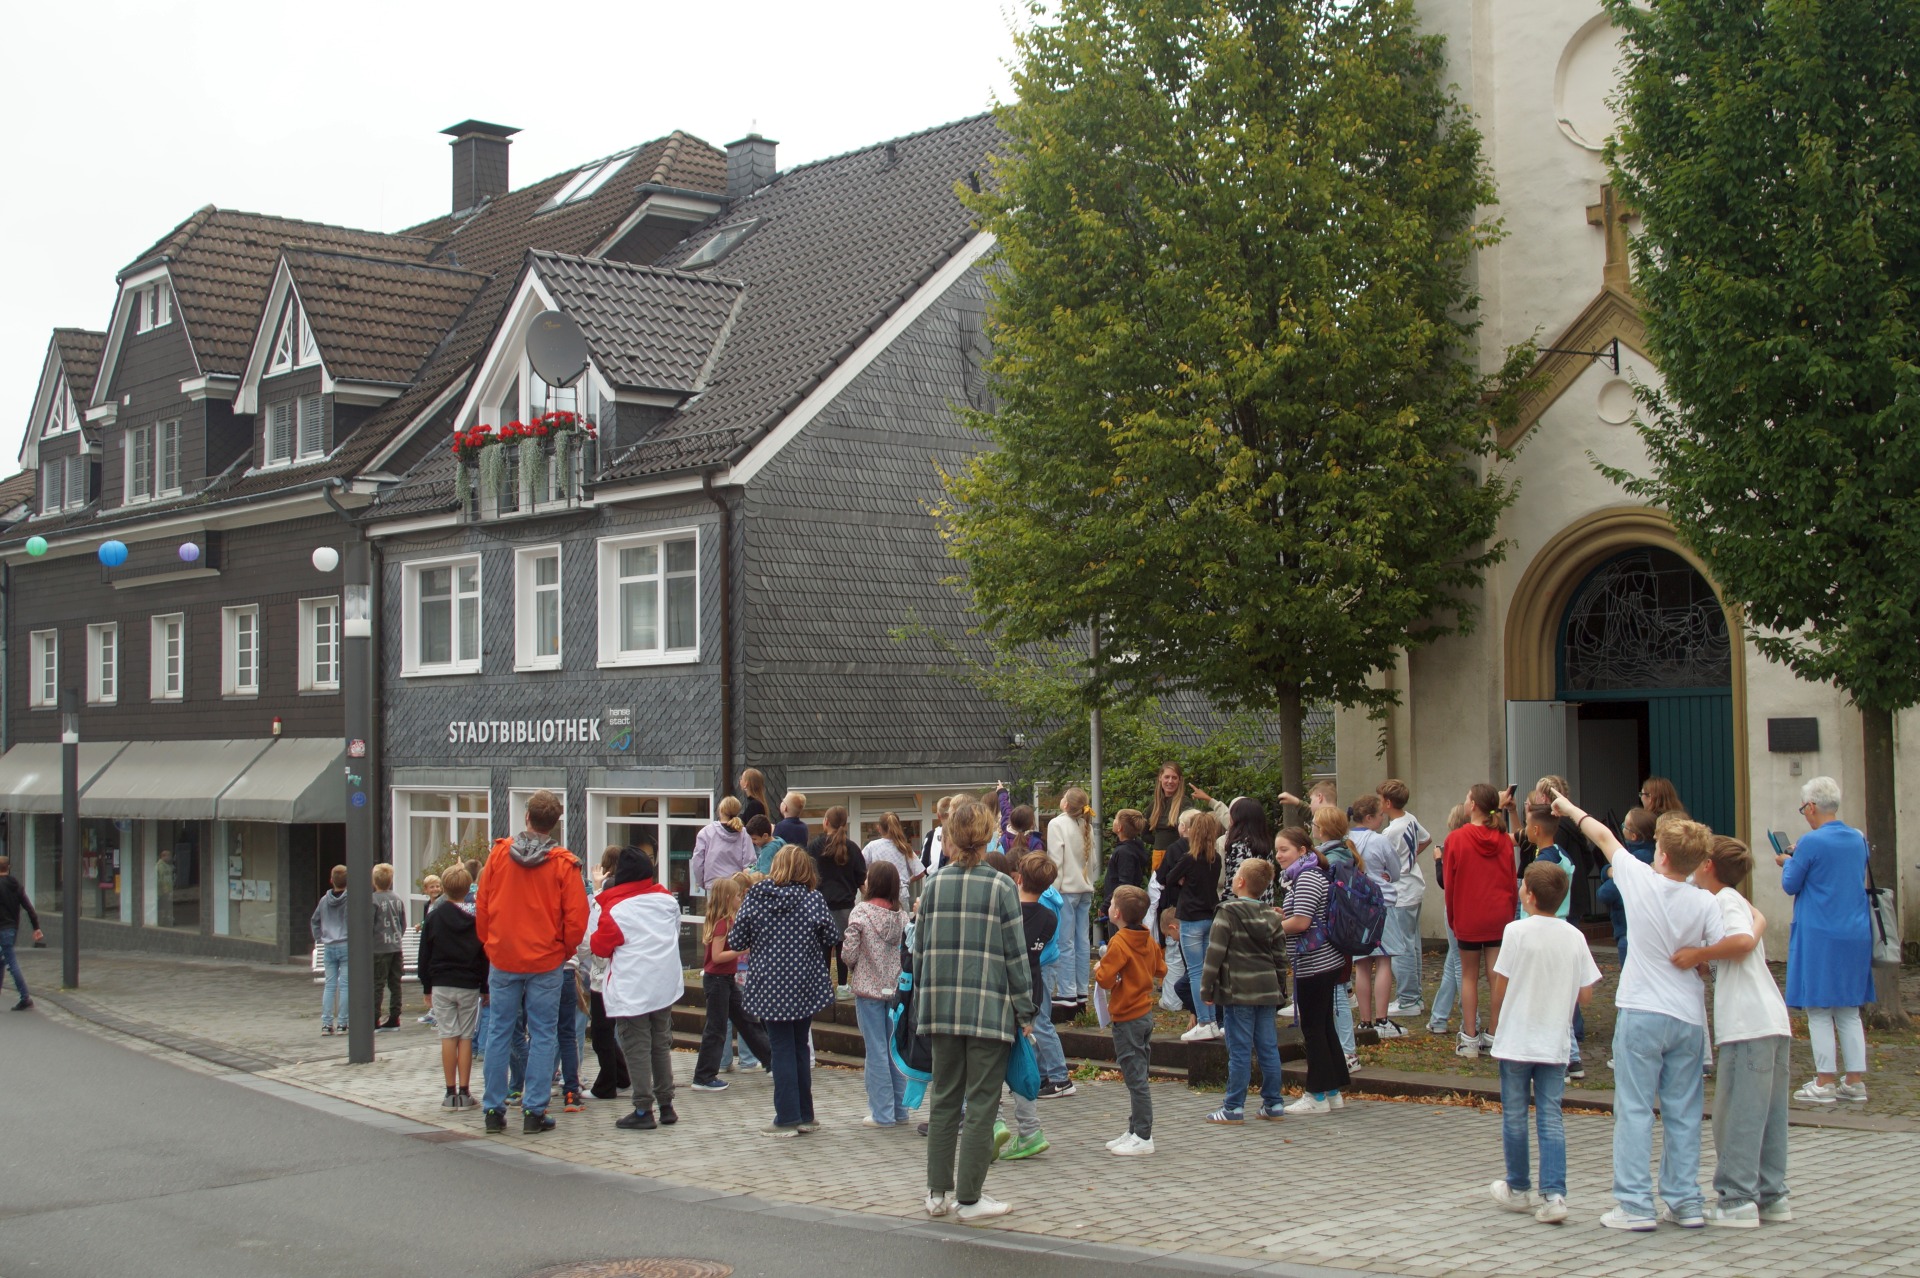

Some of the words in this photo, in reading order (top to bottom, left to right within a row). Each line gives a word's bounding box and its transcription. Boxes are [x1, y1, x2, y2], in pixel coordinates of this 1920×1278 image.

[609, 708, 631, 716] hanse
[609, 717, 631, 725] stadt
[449, 718, 601, 743] STADTBIBLIOTHEK
